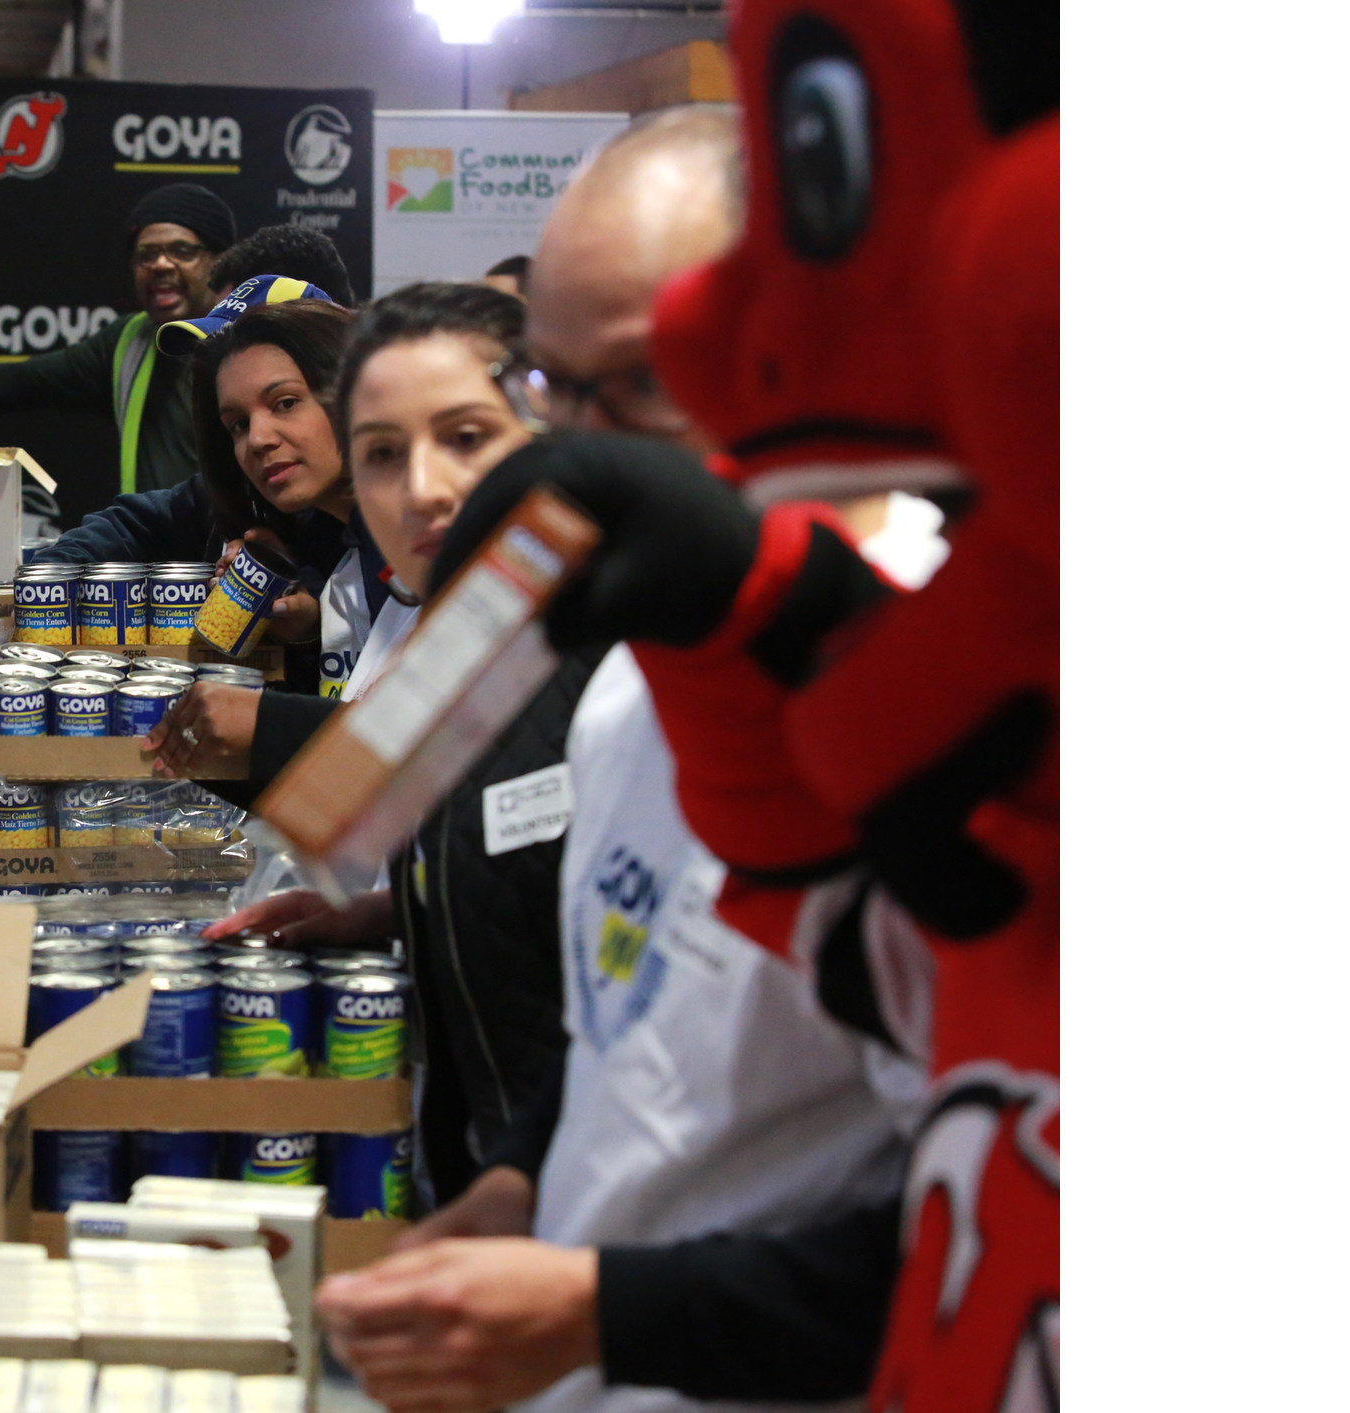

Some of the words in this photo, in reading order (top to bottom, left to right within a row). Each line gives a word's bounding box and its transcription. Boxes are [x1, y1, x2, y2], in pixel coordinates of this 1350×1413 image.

[113, 113, 242, 161] GOYA
[212, 298, 248, 313] OYA
[232, 553, 268, 589] OYA
[14, 585, 65, 603] GOYA
[152, 584, 206, 603] GOYA
[21, 610, 44, 618] Golden
[91, 609, 109, 617] Corn
[189, 609, 199, 617] Co
[25, 618, 44, 626] Tierno
[46, 618, 67, 626] Entero
[90, 617, 110, 625] Entero
[166, 617, 188, 625] Tierno
[320, 650, 361, 680] OY
[0, 693, 45, 712] GOYA
[59, 697, 105, 713] GOYA
[11, 812, 37, 820] Golden
[17, 820, 36, 828] Tierno
[224, 993, 276, 1017] OYA
